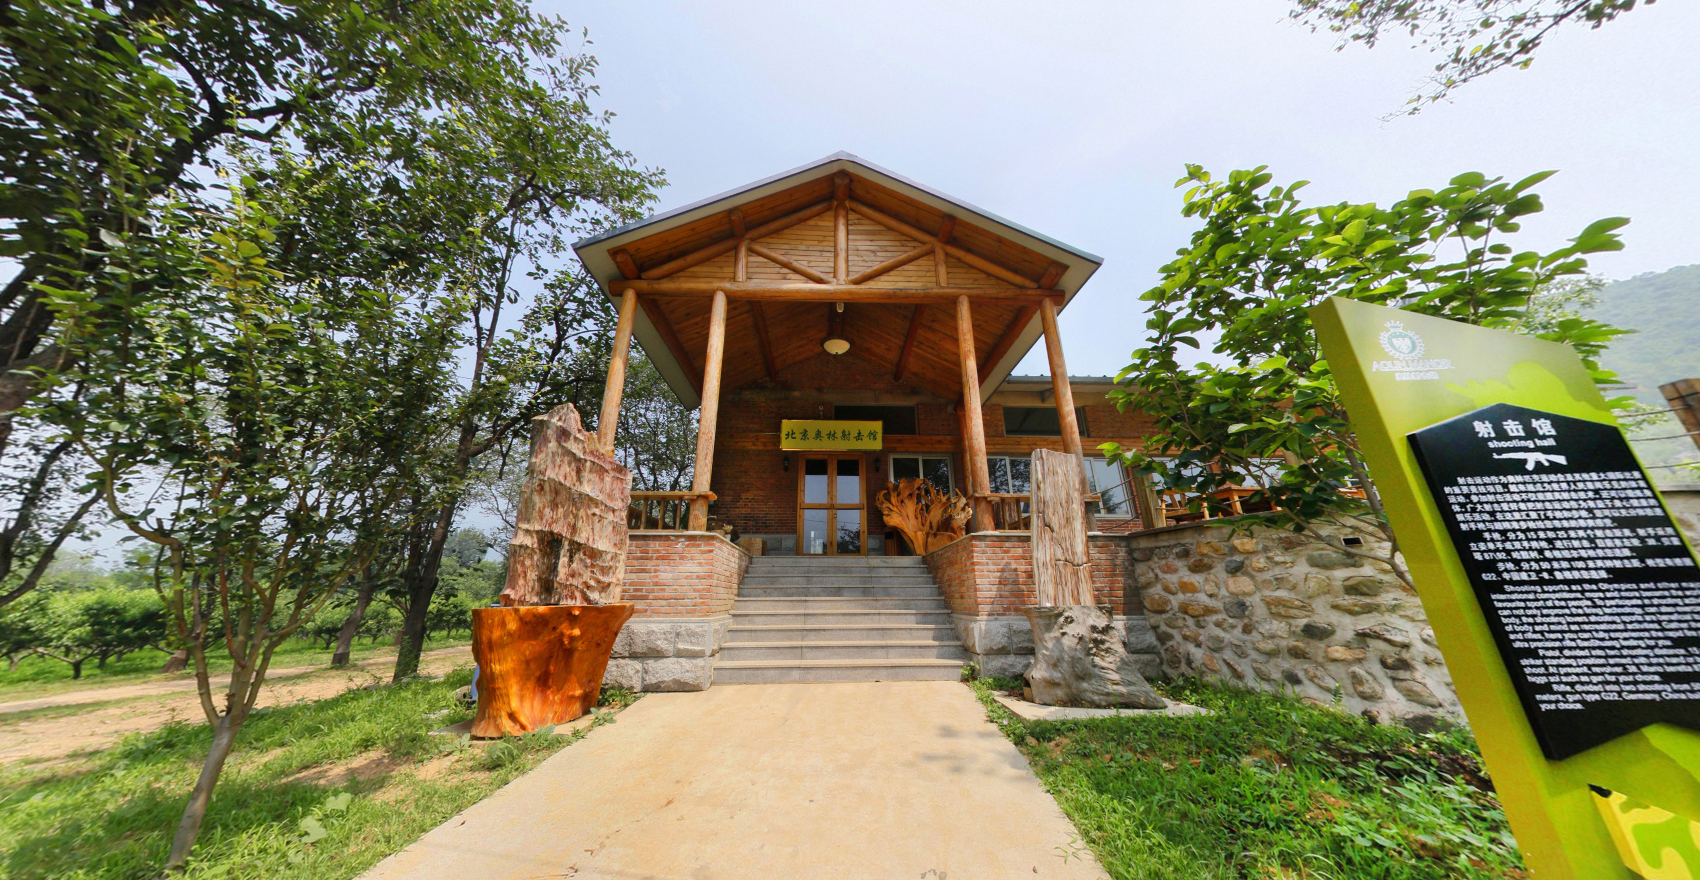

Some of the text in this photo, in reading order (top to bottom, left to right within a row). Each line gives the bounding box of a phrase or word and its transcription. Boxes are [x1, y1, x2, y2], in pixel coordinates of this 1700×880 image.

[1473, 418, 1557, 438] 射击馆
[785, 429, 878, 442] 北京奥林射击馆
[1487, 438, 1556, 448] shooting hall
